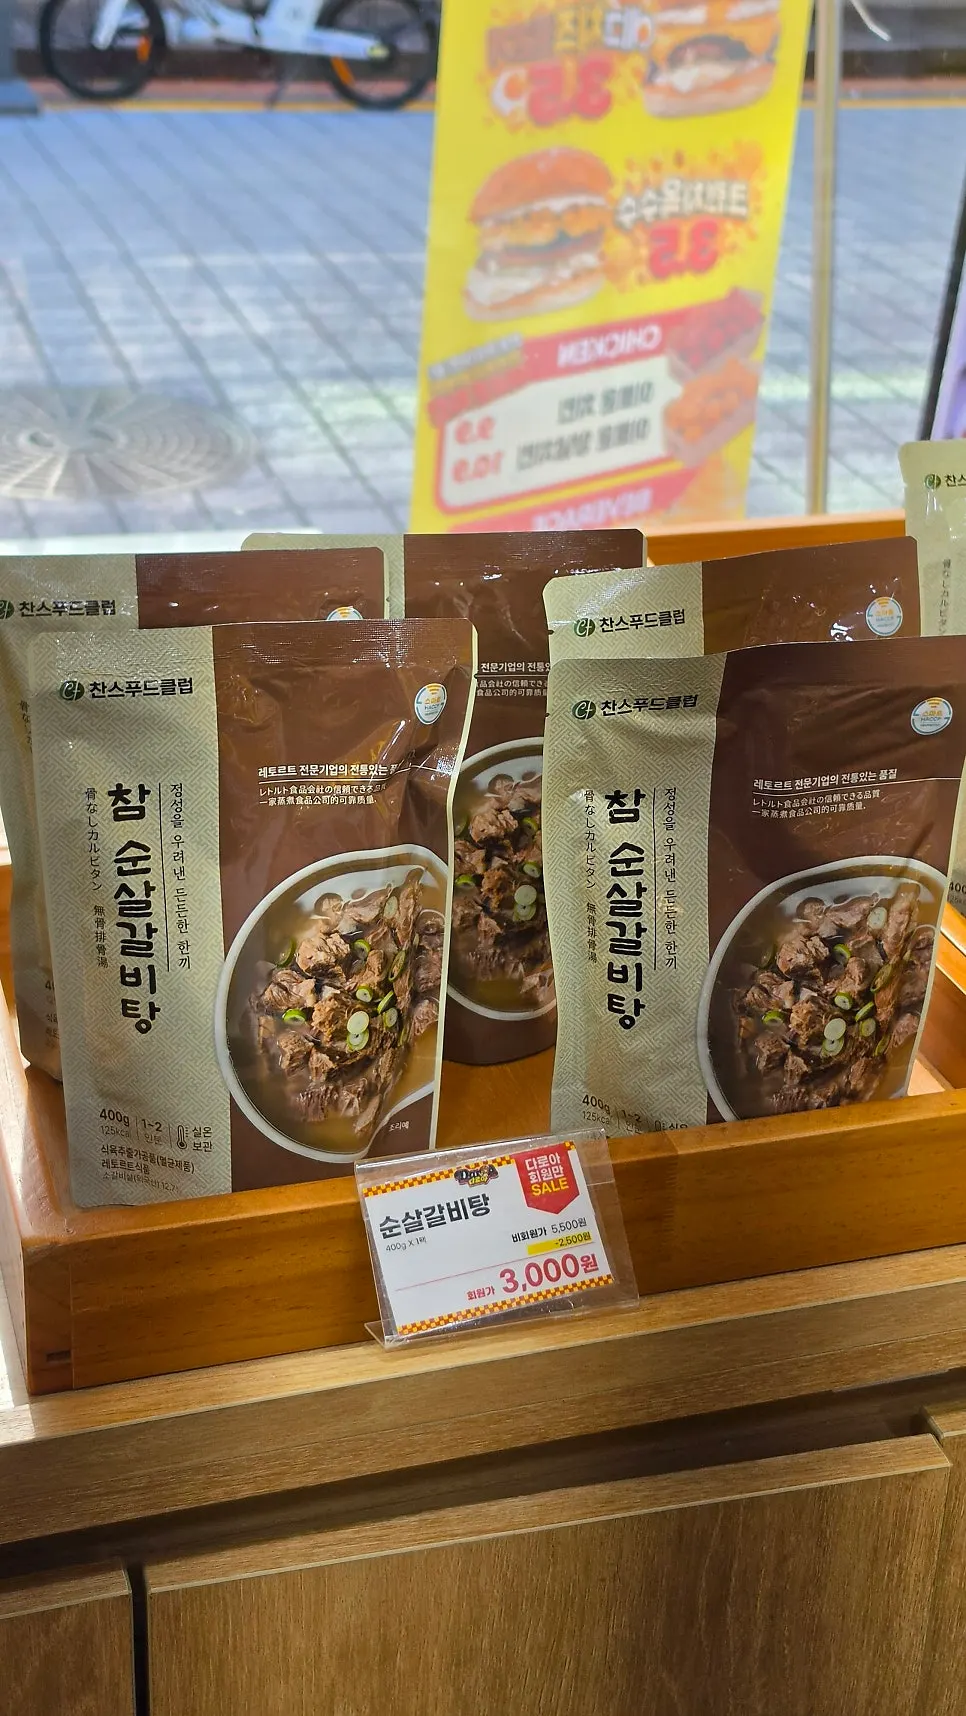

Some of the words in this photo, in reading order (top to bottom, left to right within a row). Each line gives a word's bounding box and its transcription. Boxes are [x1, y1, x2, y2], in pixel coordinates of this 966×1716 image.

[19, 600, 116, 617] 찬스푸드클럽
[600, 609, 685, 632] 찬스푸드클럽
[481, 662, 525, 673] 전문기업의
[89, 677, 193, 698] 찬스푸드클럽
[601, 694, 698, 716] 찬스푸드클럽
[258, 766, 297, 778] 레토르트
[299, 764, 348, 776] 전문기업의
[349, 763, 388, 776] 전통있는
[753, 779, 793, 790] 레토르트
[794, 774, 839, 790] 전문기업의
[841, 771, 877, 784] 전통있는
[879, 768, 898, 780] 품질
[107, 783, 151, 822] 참
[170, 783, 185, 828] 정성을
[604, 789, 646, 824] 참
[663, 787, 676, 831] 정성을
[85, 787, 102, 891] 骨なしカルビタン
[583, 789, 596, 889] 骨なしカルビタン
[171, 834, 186, 880] 우려낸
[663, 837, 676, 883] 우려낸
[174, 887, 189, 934] 든든한
[664, 889, 677, 935] 든든한
[113, 839, 161, 1034] 순살갈비탕
[605, 842, 647, 1030] 순살갈비탕
[177, 940, 191, 970] 한끼
[664, 940, 677, 969] 한끼
[582, 1095, 610, 1115] 400g
[100, 1108, 130, 1127] 400g
[141, 1119, 162, 1132] 1~2
[192, 1126, 213, 1138] 실온
[192, 1141, 213, 1153] 보관
[101, 1159, 150, 1175] 레토르트식품
[525, 1152, 561, 1171] 다로아
[528, 1165, 564, 1184] 회원만
[531, 1177, 569, 1196] SALE
[379, 1193, 491, 1239] 순살갈비탕
[511, 1226, 547, 1243] 비회원가
[551, 1217, 587, 1234] 5,500원
[555, 1231, 592, 1247] -2,500원
[385, 1241, 407, 1252] 400g
[466, 1286, 495, 1301] 회원가
[500, 1253, 599, 1293] 3,000원
